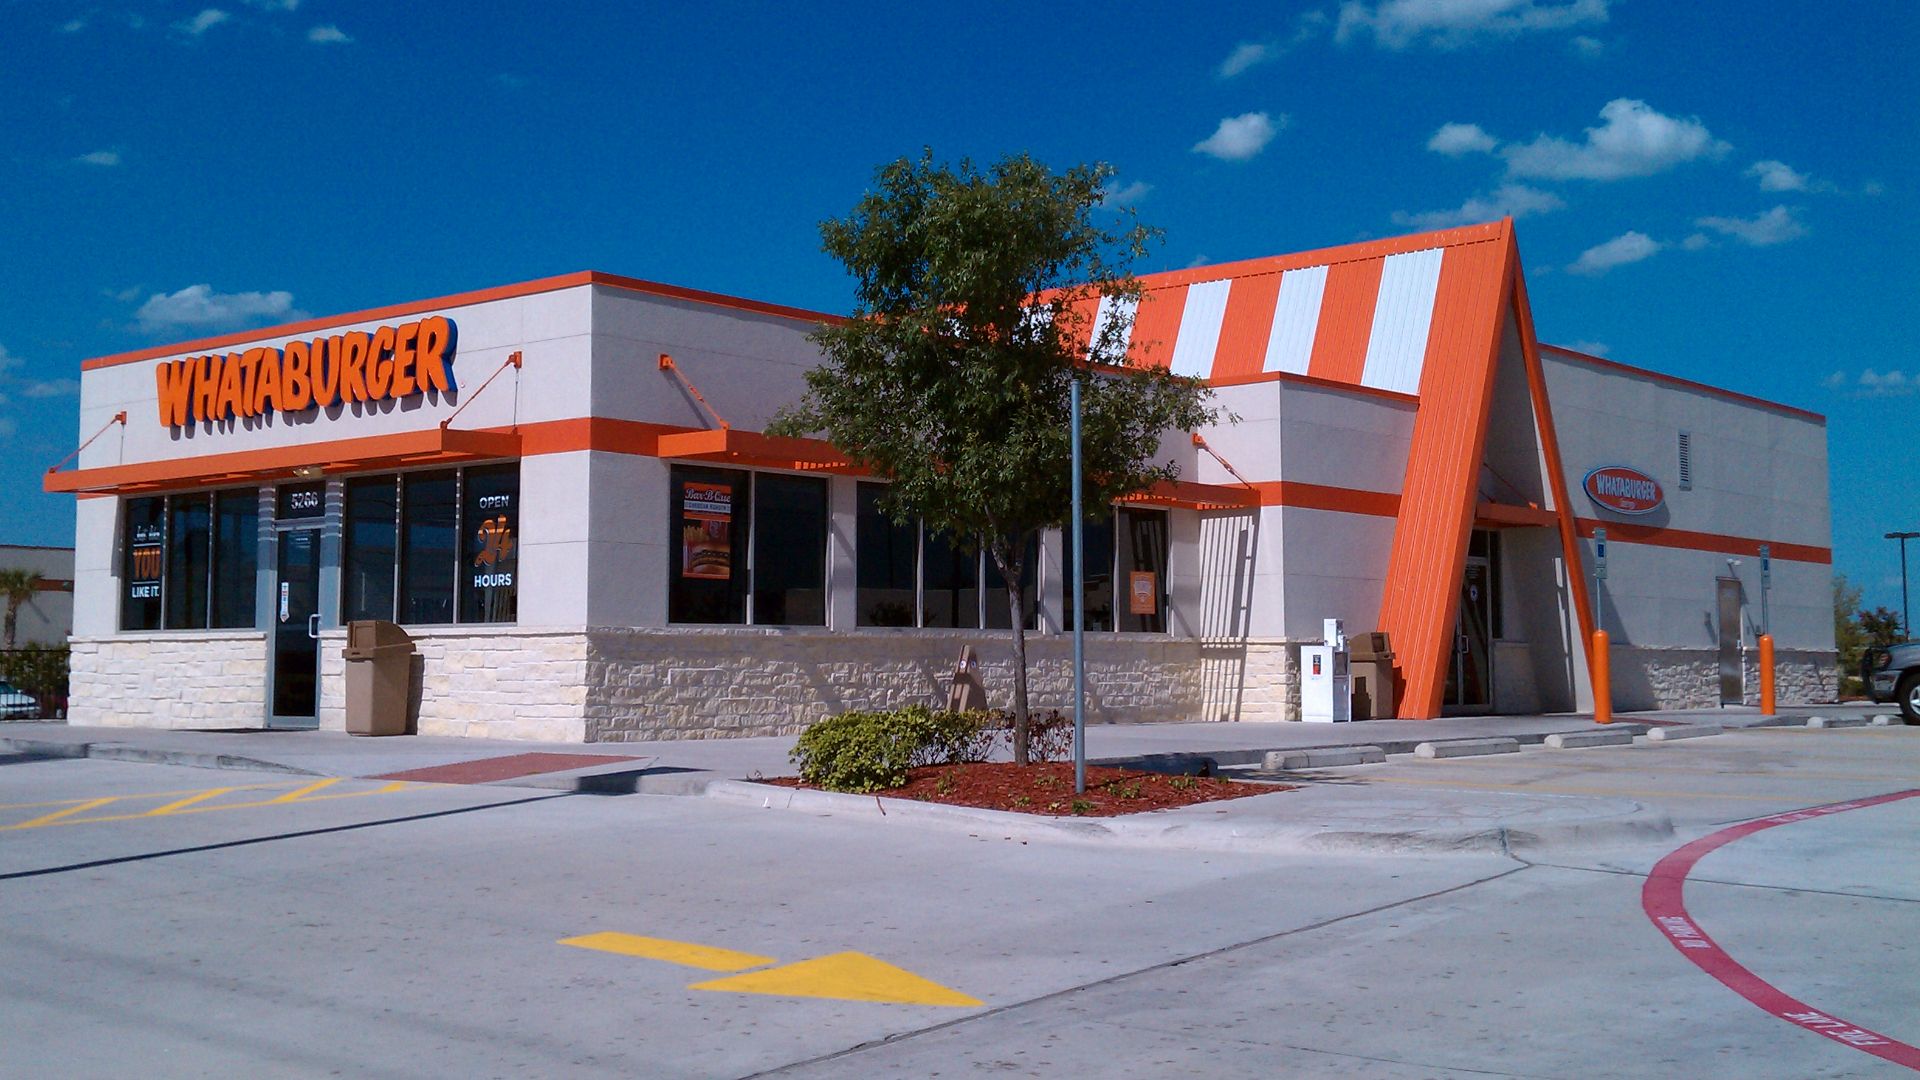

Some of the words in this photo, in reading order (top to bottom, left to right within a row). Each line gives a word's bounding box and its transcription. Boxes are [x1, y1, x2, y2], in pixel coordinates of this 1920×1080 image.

[156, 315, 457, 427] WHATABURGER
[1596, 474, 1656, 501] WHATABURGER
[291, 492, 318, 509] 5266
[479, 495, 510, 509] OPEN
[474, 513, 513, 567] 24
[133, 548, 161, 580] YOU
[474, 574, 512, 587] HOURS
[132, 587, 150, 598] LIKE
[151, 586, 160, 597] IT.
[1783, 1012, 1848, 1029] LANE
[1827, 1030, 1891, 1046] FIRE
